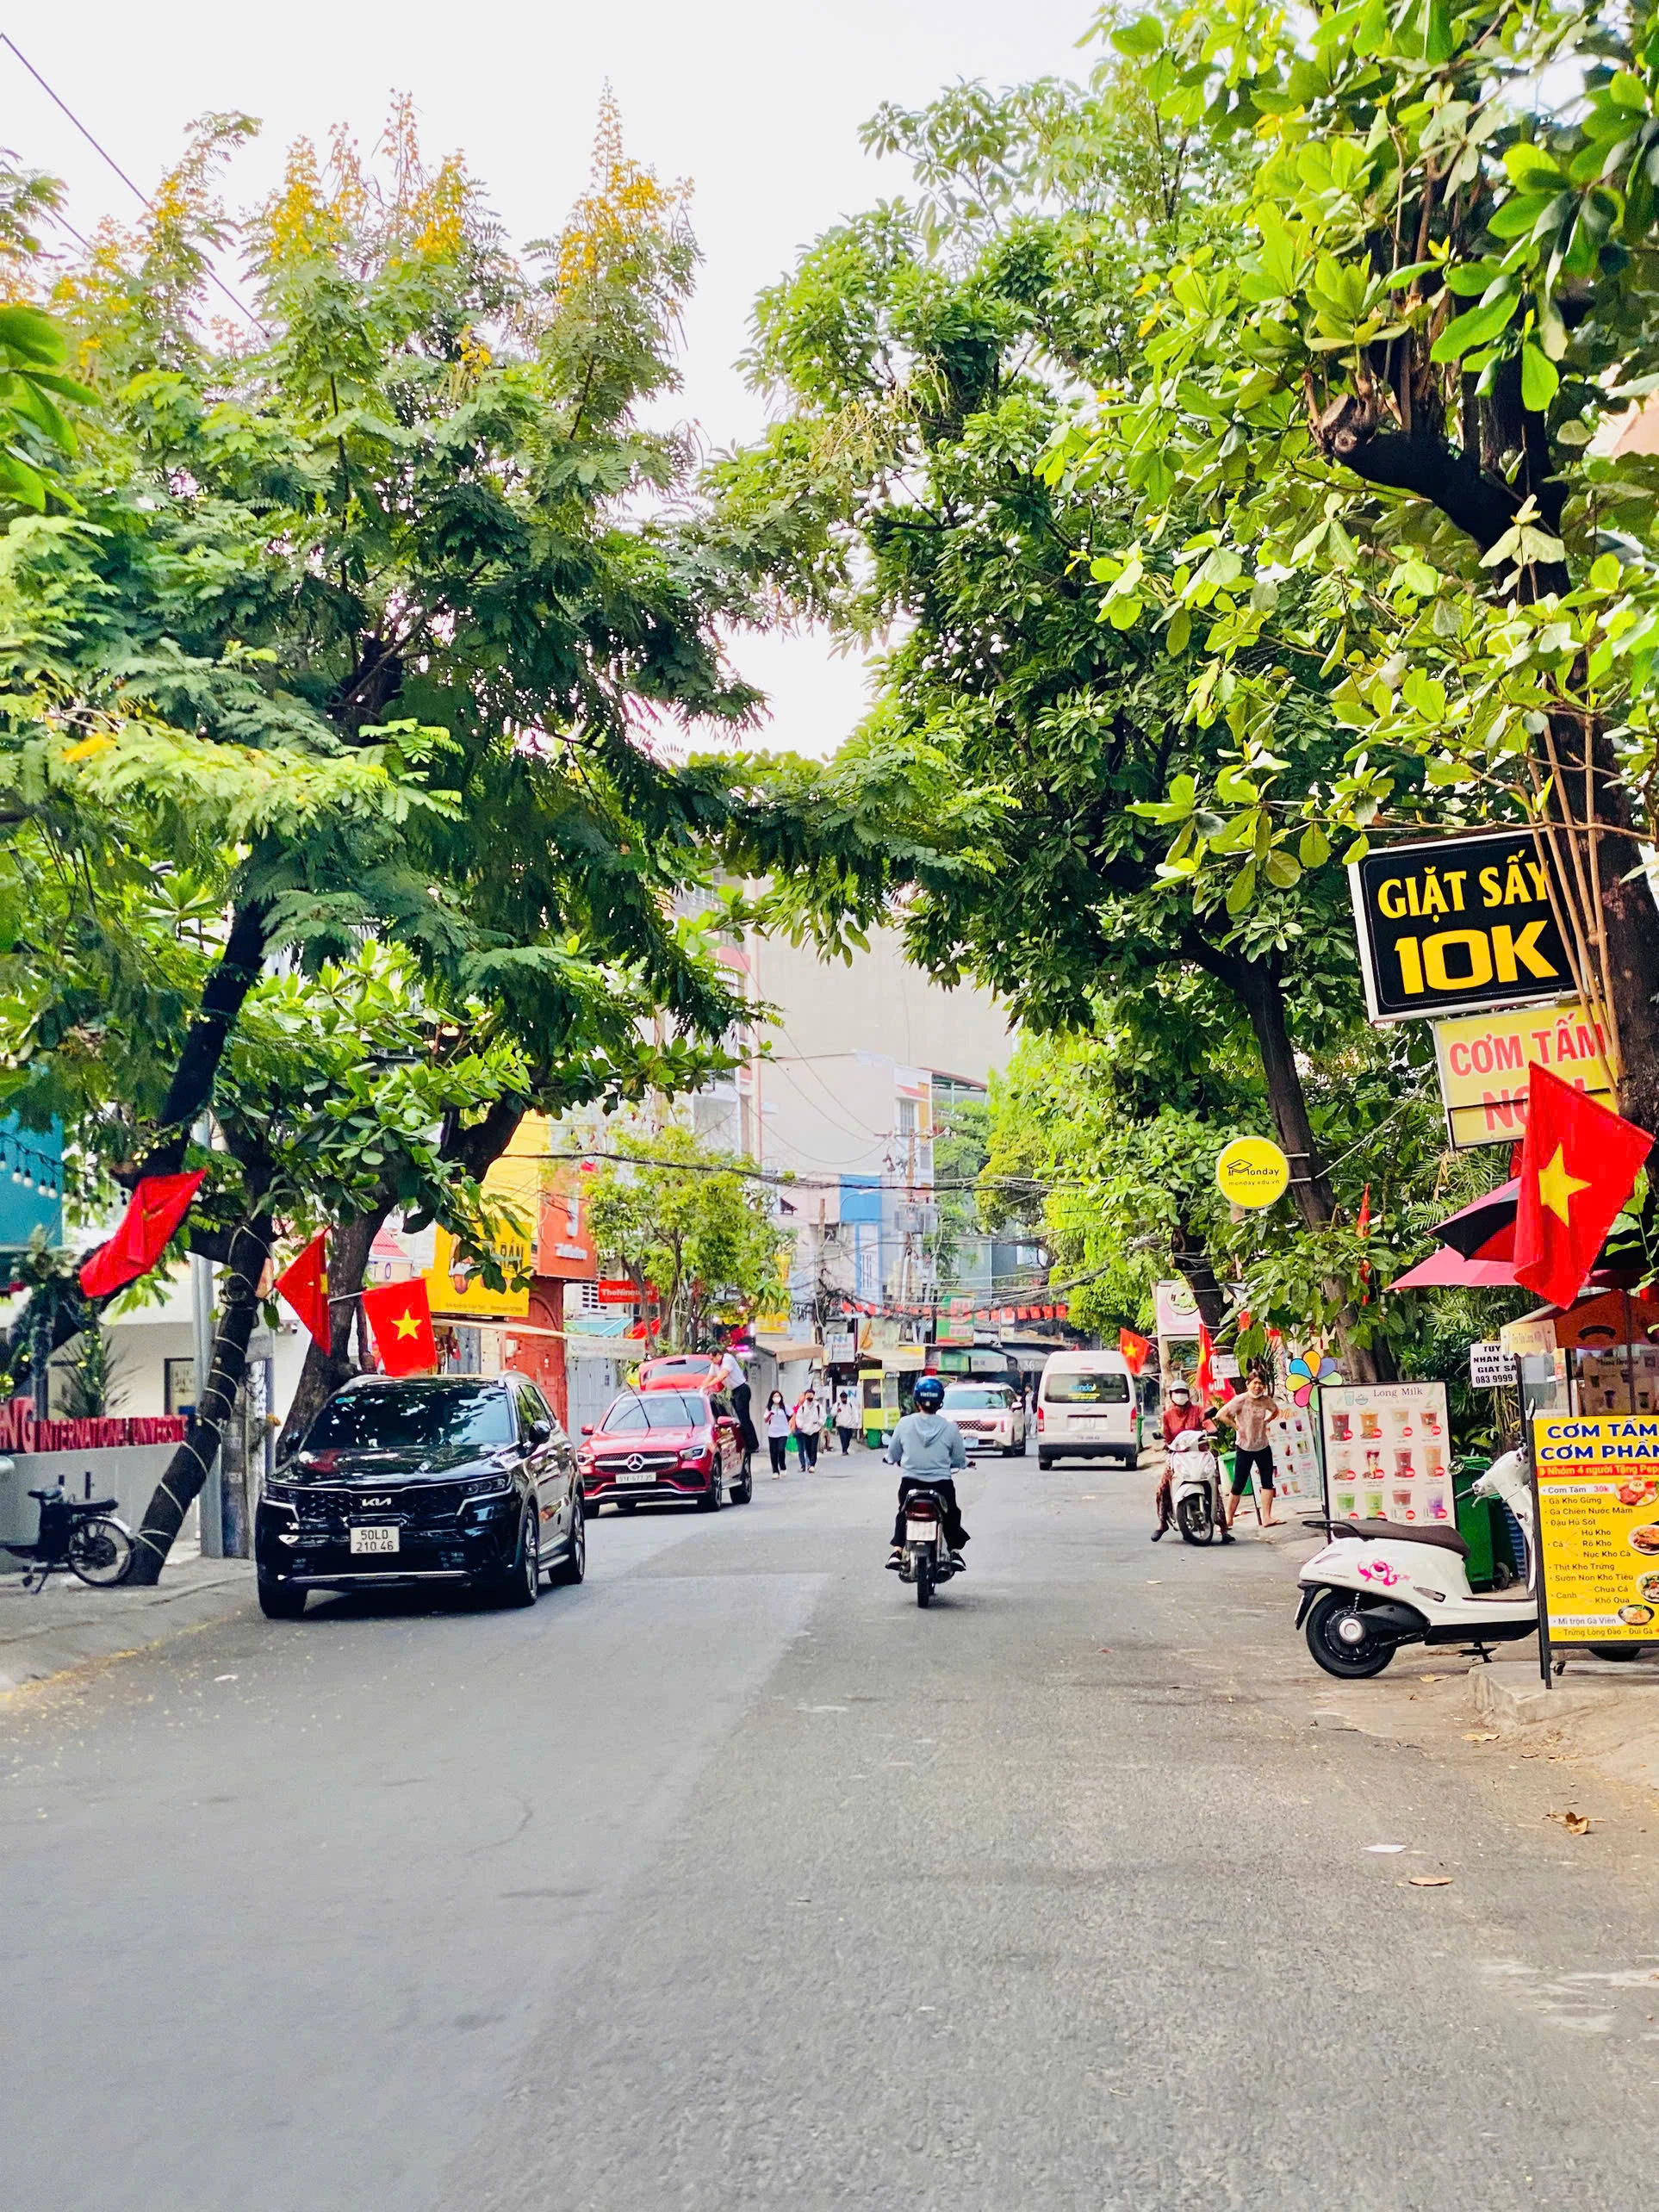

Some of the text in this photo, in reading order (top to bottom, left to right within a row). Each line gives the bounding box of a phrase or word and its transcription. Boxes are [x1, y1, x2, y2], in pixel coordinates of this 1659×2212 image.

[1377, 849, 1549, 923] GIẶT SẤY
[1394, 919, 1560, 995] 10K
[1449, 1013, 1607, 1077] CƠM TẤM
[1476, 1373, 1513, 1384] 083 9999
[1373, 1387, 1423, 1398] Long Milk
[1547, 1418, 1659, 1439] CƠM TẤM
[1540, 1444, 1594, 1460] CƠM
[362, 1497, 392, 1507] KIA
[360, 1529, 388, 1540] 50LD
[356, 1540, 394, 1552] 210.46
